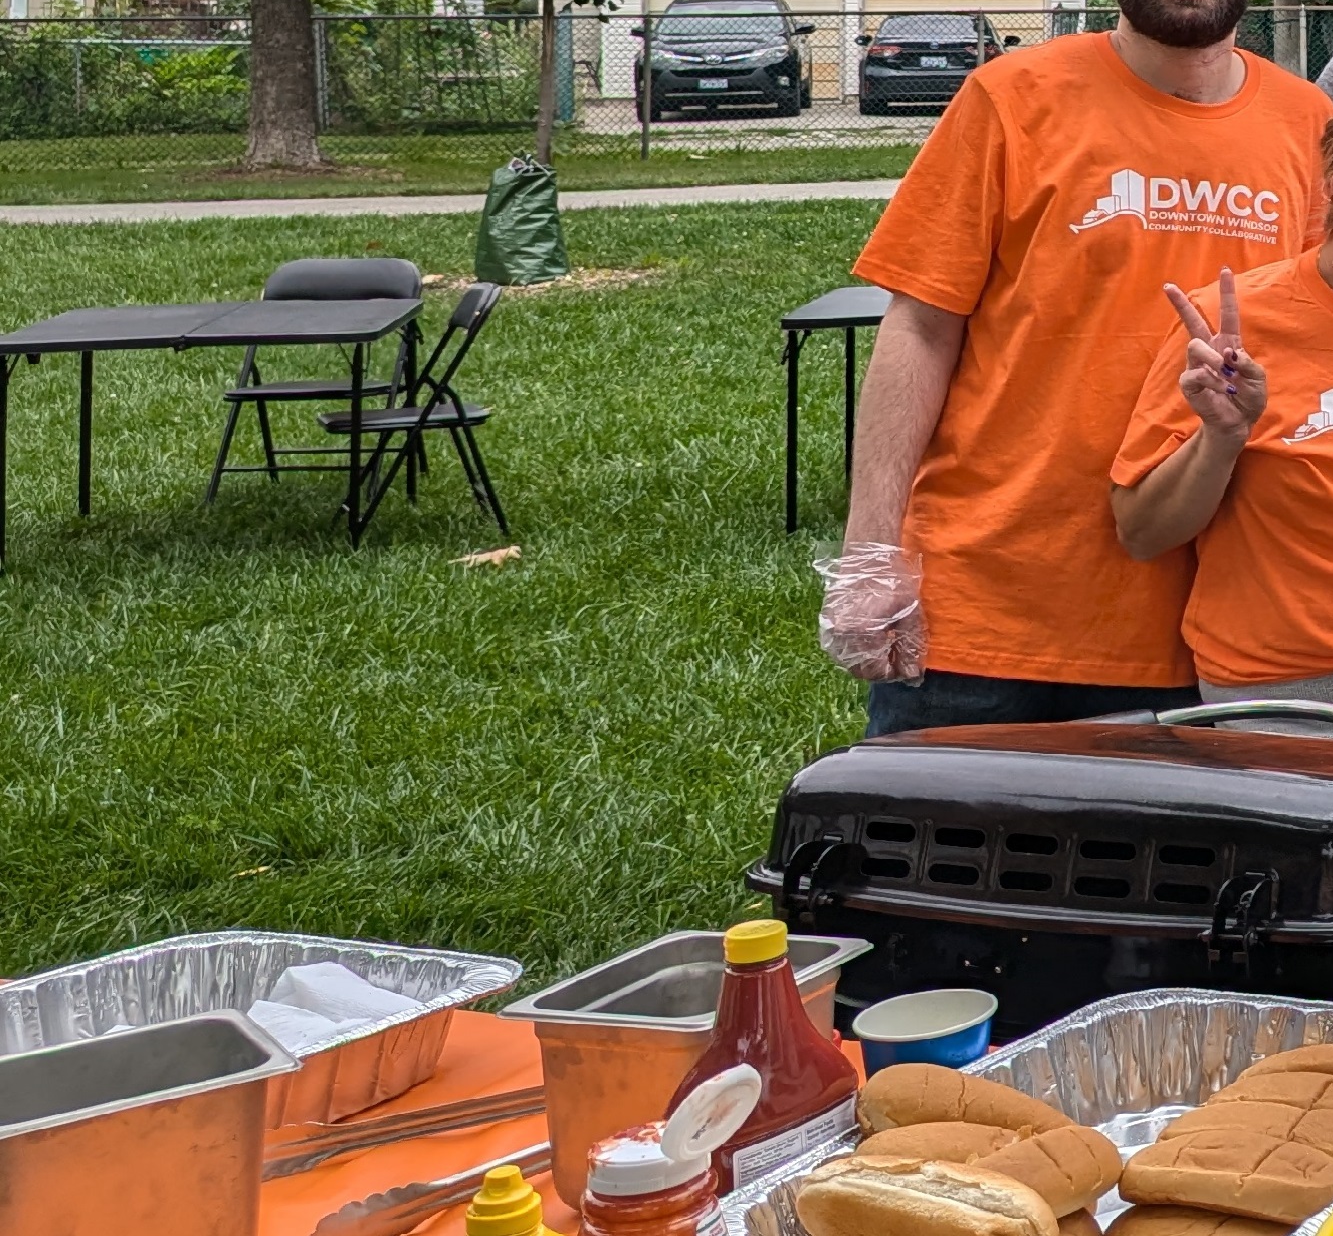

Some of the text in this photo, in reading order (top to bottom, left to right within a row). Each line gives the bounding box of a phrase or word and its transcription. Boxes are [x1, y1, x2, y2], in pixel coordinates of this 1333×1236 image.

[1150, 177, 1280, 221] DWCC
[1148, 222, 1277, 245] COMMUNITY COLLABORATIVE
[1149, 210, 1279, 234] DOWNTOWN WINDSOR
